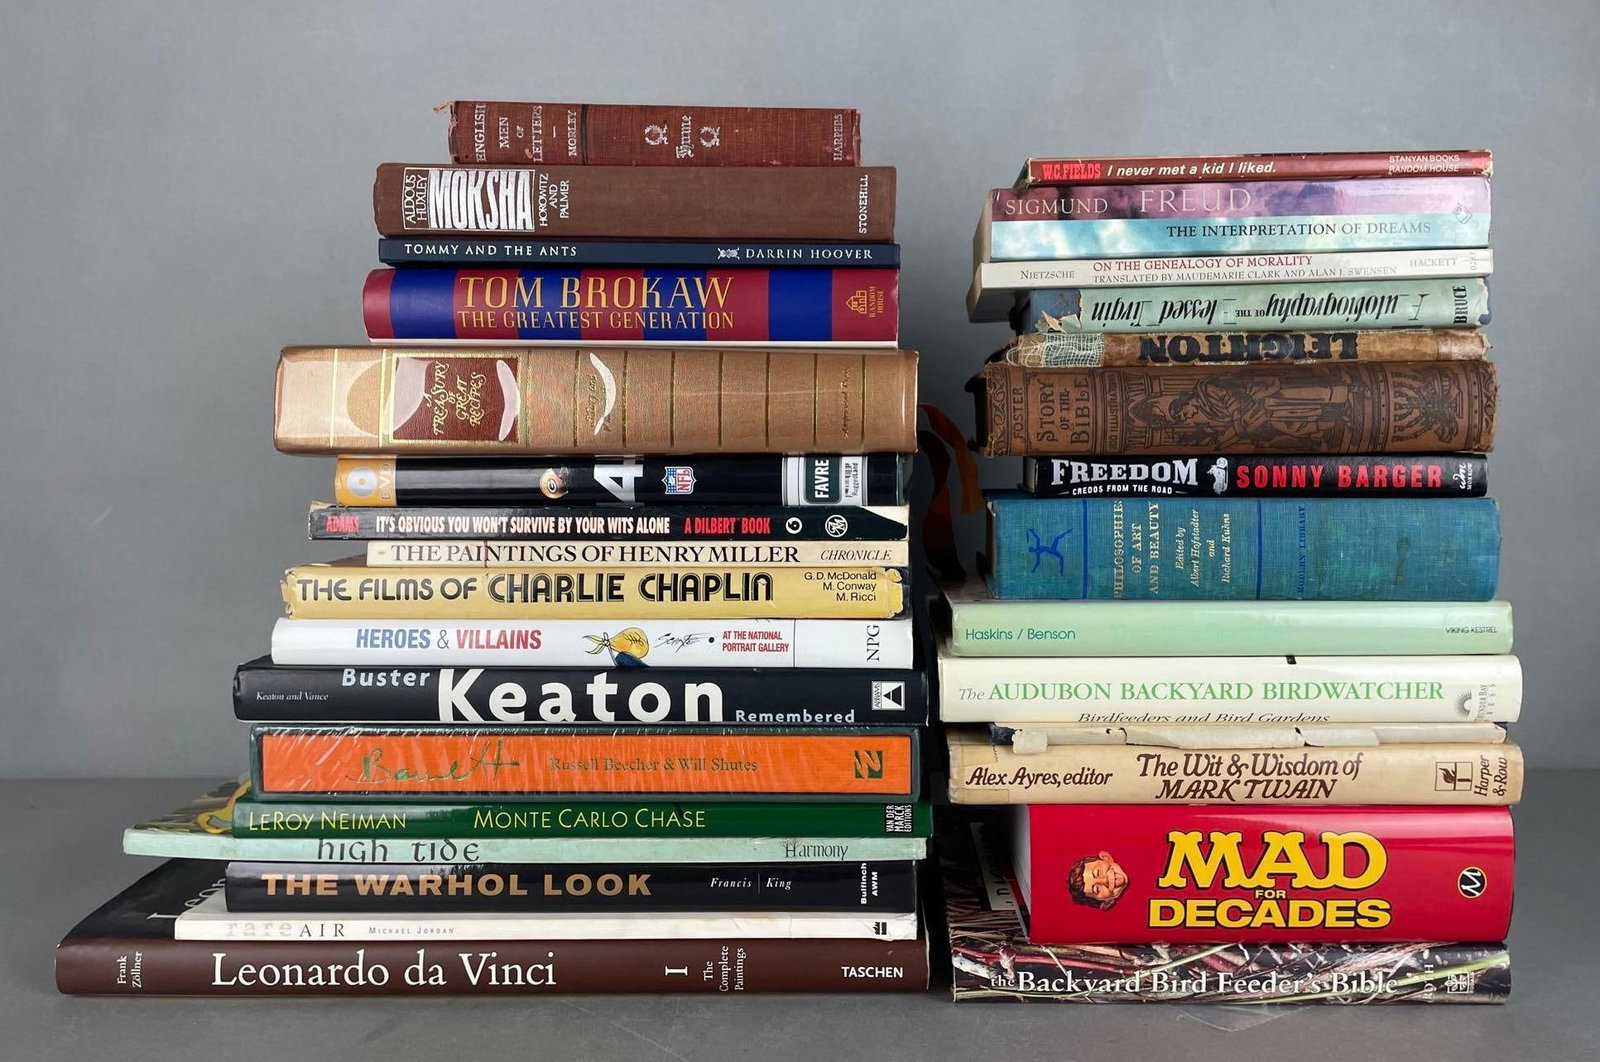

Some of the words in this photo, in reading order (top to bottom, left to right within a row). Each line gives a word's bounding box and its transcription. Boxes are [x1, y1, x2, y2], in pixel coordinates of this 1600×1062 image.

[476, 105, 487, 162] ENGLISH
[500, 116, 510, 149] MEN
[532, 105, 542, 162] LETTERS
[568, 110, 577, 156] MORLEY
[1107, 165, 1113, 176] I
[1116, 166, 1154, 176] never
[1158, 164, 1185, 176] met
[1189, 166, 1197, 175] a
[1202, 163, 1224, 174] kid
[1229, 163, 1235, 174] I
[1238, 162, 1277, 174] liked.
[404, 174, 416, 224] ALDOUS
[416, 174, 428, 222] HUXLEY
[429, 170, 533, 230] MOKSHA
[540, 173, 549, 226] HOROWITZ
[560, 180, 569, 218] PALMER
[858, 174, 868, 234] STONEHILL
[1005, 198, 1108, 216] SIGMUND
[1140, 188, 1252, 212] FREUD
[1166, 226, 1197, 238] THE
[1202, 223, 1337, 237] INTERPRETATION
[1342, 222, 1362, 234] OF
[1367, 222, 1431, 235] DREAMS
[404, 243, 458, 255] TOMMY
[465, 244, 497, 256] AND
[504, 245, 532, 256] THE
[540, 246, 577, 256] ANTS
[746, 248, 802, 259] DARRIN
[810, 248, 872, 260] HOOVER
[1092, 261, 1113, 272] ON
[1116, 260, 1141, 271] THE
[1144, 258, 1222, 270] GENEALOGY
[1226, 257, 1243, 268] OF
[1247, 255, 1312, 268] MORALITY
[1410, 257, 1458, 268] HACKETT
[1093, 274, 1159, 284] TRANSLATED
[1162, 272, 1173, 282] BY
[1176, 271, 1244, 282] MAUDEMARIE
[1248, 269, 1280, 280] CLARK
[1284, 269, 1306, 278] AND
[1308, 268, 1337, 278] ALAN
[1348, 266, 1397, 276] SWENSEN
[459, 276, 544, 308] TOM
[560, 277, 735, 309] BROKAW
[1452, 285, 1468, 324] BRUCE
[458, 310, 498, 328] THE
[502, 310, 603, 329] GREATEST
[610, 311, 734, 330] GENERATION
[1138, 332, 1358, 364] LEIGHTON
[430, 361, 450, 436] TREASURY
[1036, 380, 1058, 442] STORY
[1071, 378, 1090, 446] BIBLE
[1012, 386, 1024, 440] FOSTER
[814, 459, 830, 498] FAVRE
[1051, 458, 1198, 486] FREEDOM
[1236, 464, 1324, 488] SONNY
[1338, 464, 1442, 488] BARGER
[1072, 485, 1104, 496] CREDOS
[1106, 484, 1129, 494] FROM
[1132, 484, 1149, 492] THE
[1151, 485, 1172, 495] ROAD
[376, 516, 396, 533] IT'S
[398, 516, 445, 533] OBVIOUS
[448, 516, 470, 533] YOU
[472, 516, 509, 534] WON'T
[510, 516, 556, 534] SURVIVE
[557, 517, 572, 534] BY
[574, 517, 604, 534] YOUR
[608, 517, 634, 534] WITS
[636, 517, 670, 534] ALONE
[684, 518, 693, 534] A
[742, 518, 770, 534] BOOK
[1148, 502, 1160, 559] BEAUTY
[390, 544, 442, 562] THE
[448, 544, 576, 562] PAINTINGS
[582, 546, 616, 562] OF
[620, 546, 704, 562] HENRY
[708, 546, 800, 562] MILLER
[820, 550, 892, 562] CHRONICLE
[297, 578, 352, 601] THE
[359, 578, 433, 600] FILMS
[440, 578, 478, 600] OF
[488, 572, 625, 603] CHARLIE
[638, 572, 774, 602] CHAPLIN
[1148, 561, 1159, 594] AND
[356, 628, 430, 650] HEROES
[436, 630, 450, 650] &
[456, 629, 542, 650] VILLAINS
[722, 630, 733, 640] AT
[734, 630, 747, 640] THE
[748, 631, 782, 641] NATIONAL
[722, 642, 757, 652] PORTRAIT
[758, 642, 790, 652] GALLERY
[867, 624, 880, 662] NPG
[965, 628, 1013, 640] Haskins
[1027, 628, 1076, 640] Benson
[256, 690, 285, 701] Keaton
[286, 690, 302, 701] and
[304, 690, 329, 701] Vance
[342, 668, 430, 686] Buster
[438, 668, 723, 724] Keaton
[959, 688, 985, 700] The
[989, 682, 1112, 701] AUDUBON
[1120, 682, 1254, 701] BACKYARD
[1263, 682, 1445, 700] BIRDWATCHER
[736, 710, 855, 724] Remembered
[550, 758, 598, 771] Russell
[602, 758, 660, 772] Beecher
[663, 758, 675, 770] &
[678, 758, 707, 770] Will
[710, 758, 758, 771] Shutes
[1136, 753, 1178, 777] The
[1183, 753, 1224, 777] Wit
[1227, 754, 1249, 777] &
[1252, 753, 1338, 777] Wisdom
[1342, 752, 1364, 780] of
[1474, 755, 1491, 796] Harper
[1156, 780, 1240, 802] MARK
[1244, 778, 1338, 800] TWAIN
[320, 810, 406, 831] NEIMAN
[474, 810, 551, 828] MONTE
[558, 808, 628, 828] CARLO
[634, 808, 706, 828] CHASE
[783, 840, 848, 860] Harmony
[1157, 830, 1388, 890] MAD
[262, 874, 338, 896] THE
[354, 874, 528, 896] WARHOL
[544, 873, 652, 896] LOOK
[710, 878, 752, 888] Francis
[766, 878, 792, 890] King
[1255, 890, 1286, 899] FOR
[1148, 898, 1392, 930] DECADES
[299, 924, 345, 938] AIR
[116, 954, 128, 985] Frank
[132, 951, 143, 989] Zöllner
[212, 949, 390, 987] Leonardo
[404, 949, 448, 986] da
[458, 952, 556, 986] Vinci
[703, 960, 714, 982] The
[718, 945, 729, 992] Complete
[734, 946, 746, 992] Paintings
[842, 966, 904, 978] TASCHEN
[1016, 970, 1142, 1000] Backyard
[1152, 970, 1206, 994] Bird
[1217, 971, 1324, 994] Feeder's
[1332, 972, 1398, 994] Bible
